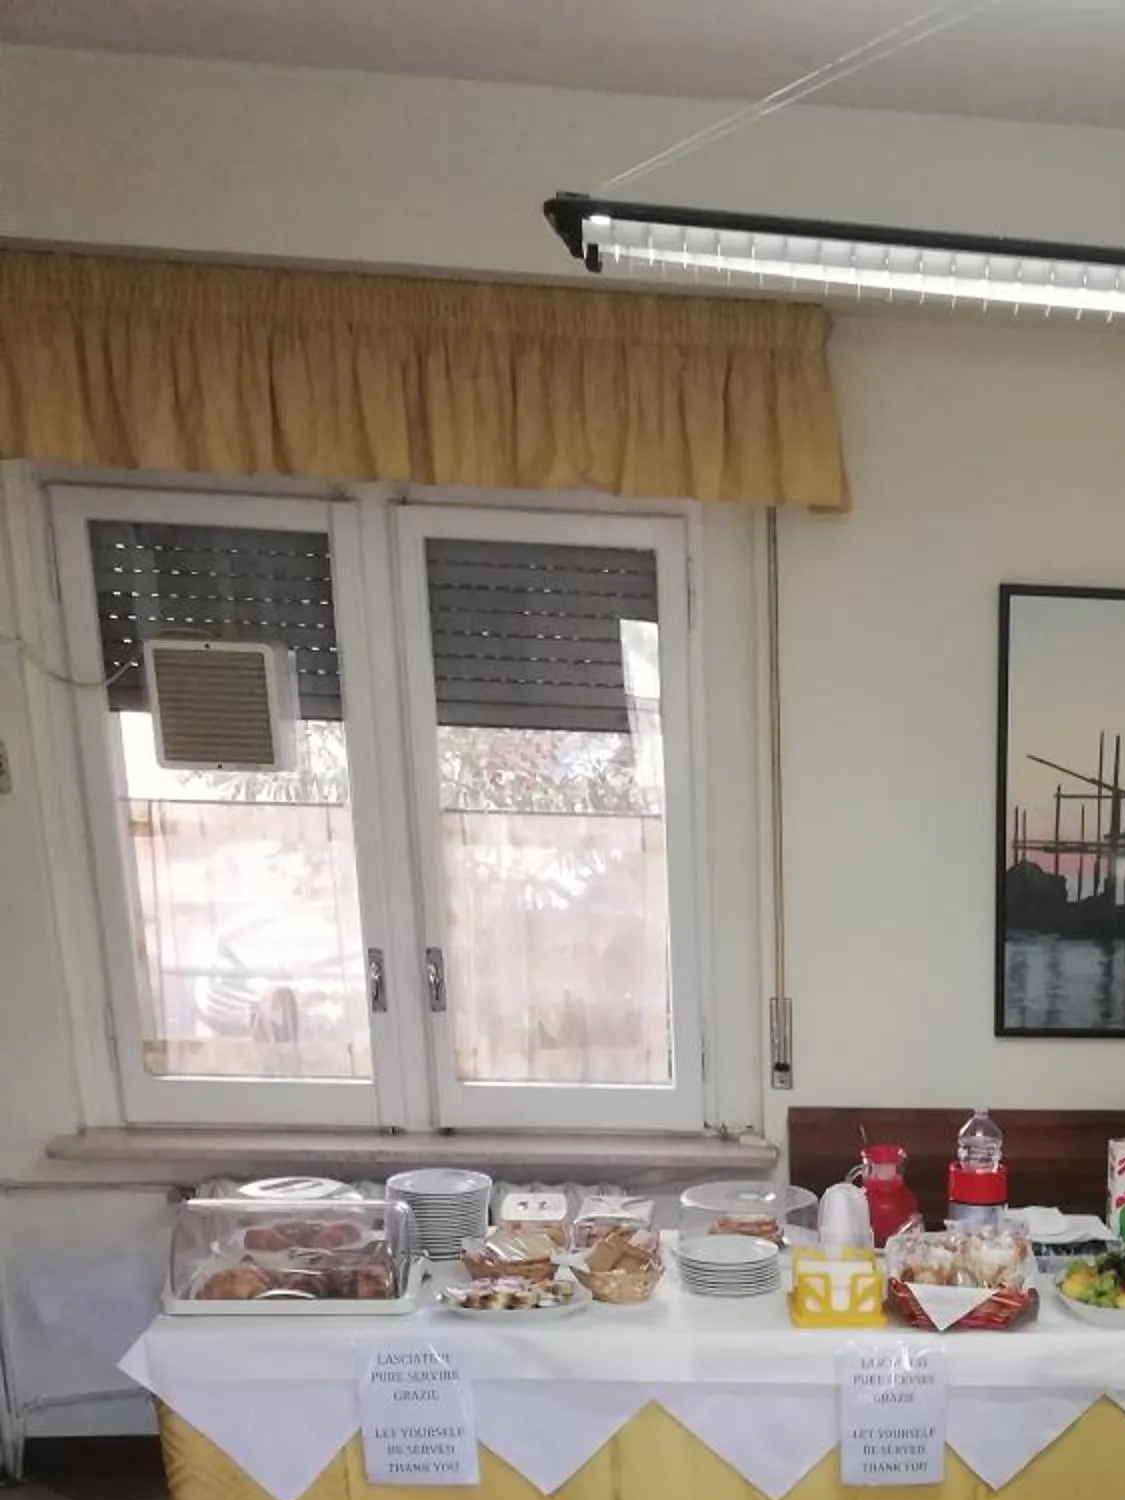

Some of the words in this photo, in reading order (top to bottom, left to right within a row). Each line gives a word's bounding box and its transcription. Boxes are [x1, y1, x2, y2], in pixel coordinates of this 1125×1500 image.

[375, 1427, 397, 1439] LET
[401, 1426, 464, 1438] YOURSELF
[853, 1429, 875, 1440] LET
[877, 1426, 936, 1439] YOURSELF
[386, 1444, 402, 1455] BE
[406, 1444, 455, 1455] SERVED
[863, 1445, 877, 1456] BE
[881, 1444, 926, 1455] SERVED
[388, 1462, 430, 1473] THANK
[433, 1461, 459, 1473] YOU
[863, 1462, 902, 1473] THANK
[904, 1461, 927, 1472] YOU
